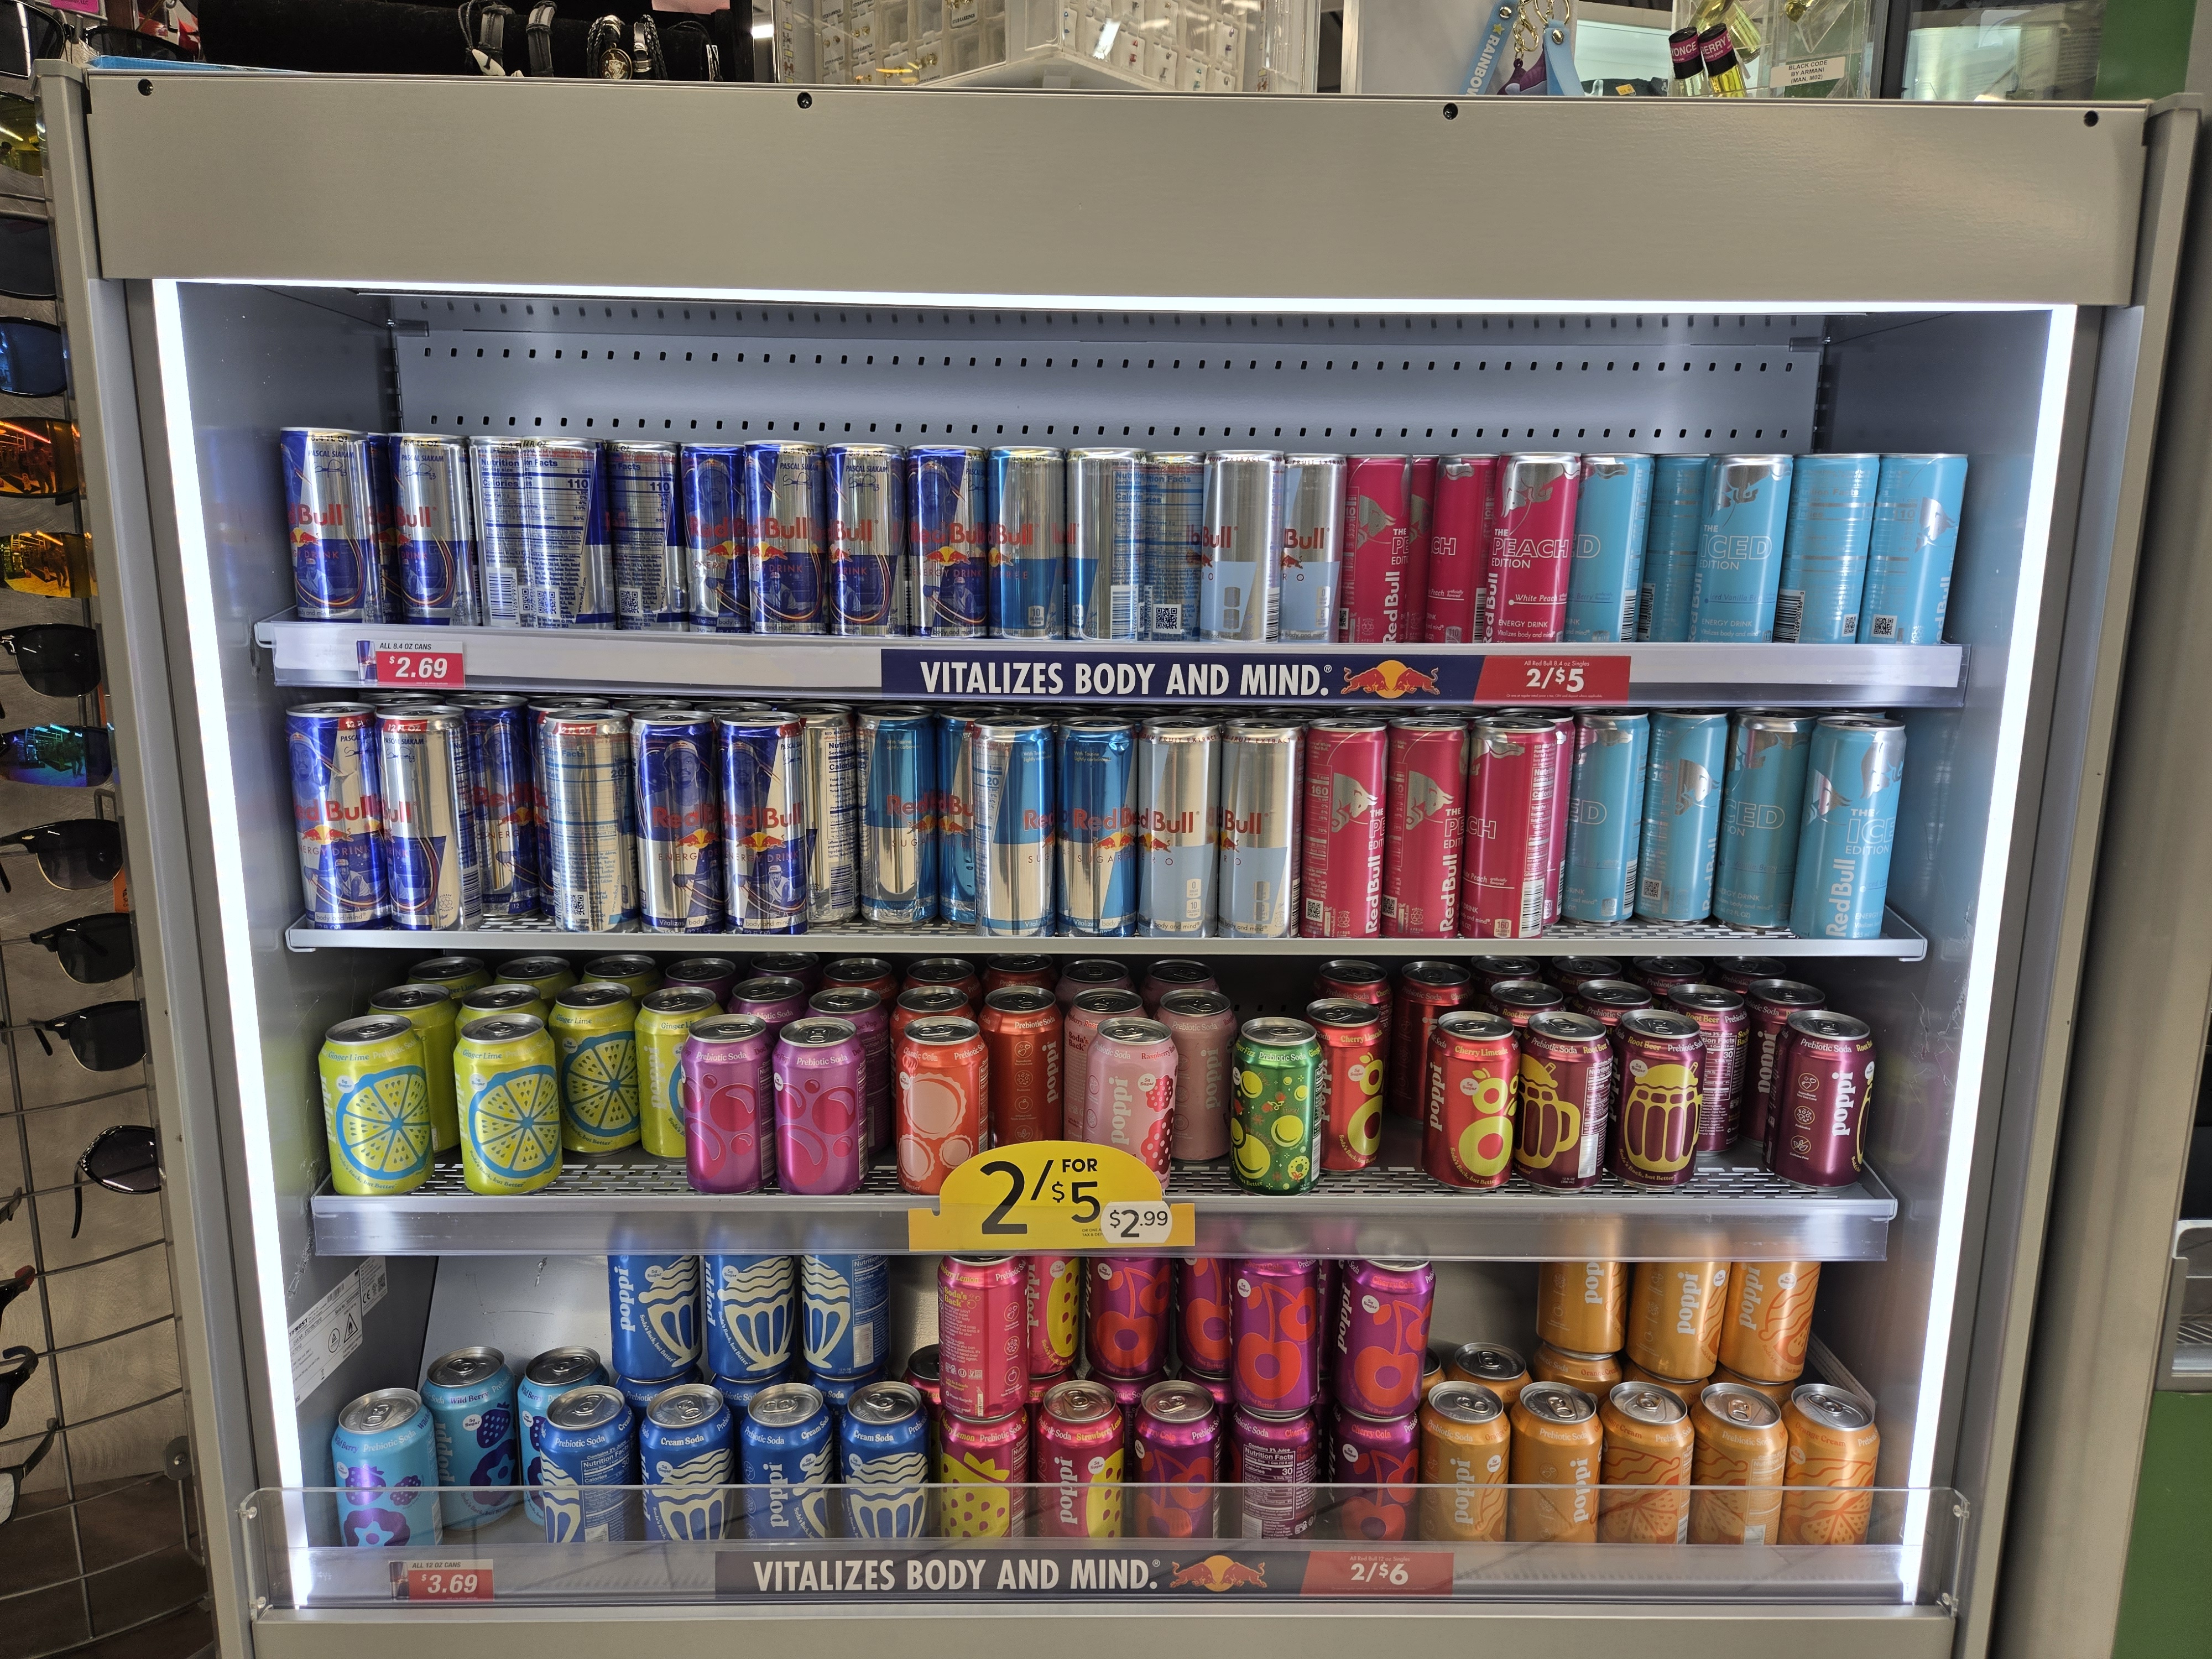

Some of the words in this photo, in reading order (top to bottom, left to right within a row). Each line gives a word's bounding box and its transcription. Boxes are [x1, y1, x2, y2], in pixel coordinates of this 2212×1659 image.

[568, 479, 588, 488] 110
[298, 504, 343, 526] Bull
[765, 518, 808, 539] Bull
[999, 524, 1034, 546] Bull
[1285, 528, 1324, 549] Bull
[1701, 533, 1772, 560] ICED
[1493, 539, 1569, 559] PEACH
[1491, 559, 1531, 568] EDITION
[1699, 561, 1739, 570] EDITION
[1385, 572, 1400, 607] Bull
[1486, 573, 1498, 609] Bull
[1515, 593, 1537, 602] White
[389, 656, 447, 679] $2.69
[920, 661, 1063, 695] VITALIZES
[1076, 664, 1154, 695] BODY
[1166, 664, 1229, 695] AND
[1526, 666, 1584, 692] 2/$5
[1311, 786, 1328, 796] 160
[763, 807, 801, 828] Bull
[1370, 808, 1384, 817] THE
[1446, 807, 1462, 816] THE
[1152, 811, 1194, 833] Bull
[1225, 811, 1262, 834] Bull
[1845, 846, 1890, 854] EDITION
[1367, 854, 1381, 894] Bull
[1442, 854, 1458, 893] Bull
[1832, 859, 1855, 896] Bull
[1738, 893, 1760, 902] DRINK
[1365, 894, 1380, 935] Red
[1439, 893, 1455, 933] Red
[1826, 898, 1852, 937] Red
[1497, 921, 1509, 929] 160
[1015, 1020, 1042, 1029] Prebiotic
[1703, 1015, 1720, 1024] Beer
[1454, 1046, 1478, 1056] Cherry
[1480, 1047, 1509, 1057] Limeade
[1532, 1037, 1559, 1053] Prebiotic
[1560, 1046, 1578, 1054] Soda
[1627, 1036, 1642, 1048] Root
[1644, 1042, 1662, 1051] Beer
[1800, 1038, 1833, 1052] Prebiotic
[1834, 1044, 1852, 1053] Soda
[328, 1052, 349, 1062] Ginger
[351, 1052, 369, 1061] Lime
[463, 1049, 482, 1060] Ginger
[482, 1052, 502, 1060] Lime
[696, 1052, 726, 1061] Prebiotic
[728, 1051, 748, 1061] Soda
[797, 1057, 828, 1066] Prebiotic
[831, 1054, 848, 1065] Soda
[1118, 1052, 1131, 1061] Soda
[1259, 1052, 1288, 1061] Prebiotic
[1290, 1052, 1307, 1061] Soda
[1723, 1050, 1733, 1059] 30
[1041, 1040, 1059, 1104] poppi
[1430, 1061, 1443, 1131] poppi
[1831, 1072, 1853, 1137] poppi
[1109, 1076, 1130, 1145] poppi
[1062, 1159, 1098, 1172] FOR
[1052, 1181, 1100, 1223] $5
[1109, 1208, 1168, 1238] $2.99
[956, 1272, 979, 1284] Lemon
[614, 1265, 635, 1333] poppi
[1677, 1271, 1700, 1335] poppi
[1739, 1264, 1764, 1331] poppi
[1337, 1282, 1350, 1355] poppi
[450, 1395, 465, 1405] Wild
[466, 1391, 489, 1404] Berry
[363, 1436, 399, 1453] Prebiotic
[399, 1430, 416, 1445] Soda
[555, 1437, 585, 1448] Prebiotic
[586, 1434, 606, 1446] Soda
[661, 1437, 684, 1447] Cream
[685, 1434, 705, 1446] Soda
[766, 1436, 785, 1446] Soda
[853, 1431, 874, 1442] Cream
[875, 1433, 894, 1442] Soda
[952, 1430, 975, 1442] Lemon
[979, 1431, 1005, 1443] Prebiotic
[1056, 1430, 1072, 1441] Soda
[1076, 1425, 1109, 1442] Strawberry
[1253, 1428, 1269, 1438] Soda
[1453, 1432, 1474, 1443] Soda
[1540, 1428, 1567, 1439] Prebiotic
[1568, 1430, 1588, 1439] Soda
[1820, 1433, 1846, 1448] Cream
[1245, 1447, 1272, 1459] Nutrition
[622, 1458, 630, 1468] 30
[1282, 1467, 1293, 1476] 30
[762, 1462, 789, 1528] poppi
[1054, 1455, 1078, 1526] poppi
[1449, 1458, 1474, 1526] poppi
[1569, 1457, 1590, 1524] poppi
[753, 1558, 895, 1593] VITALIZES
[907, 1558, 985, 1590] BODY
[996, 1558, 1061, 1590] AND
[1350, 1562, 1408, 1585] 2/$6
[421, 1574, 478, 1593] $3.69
